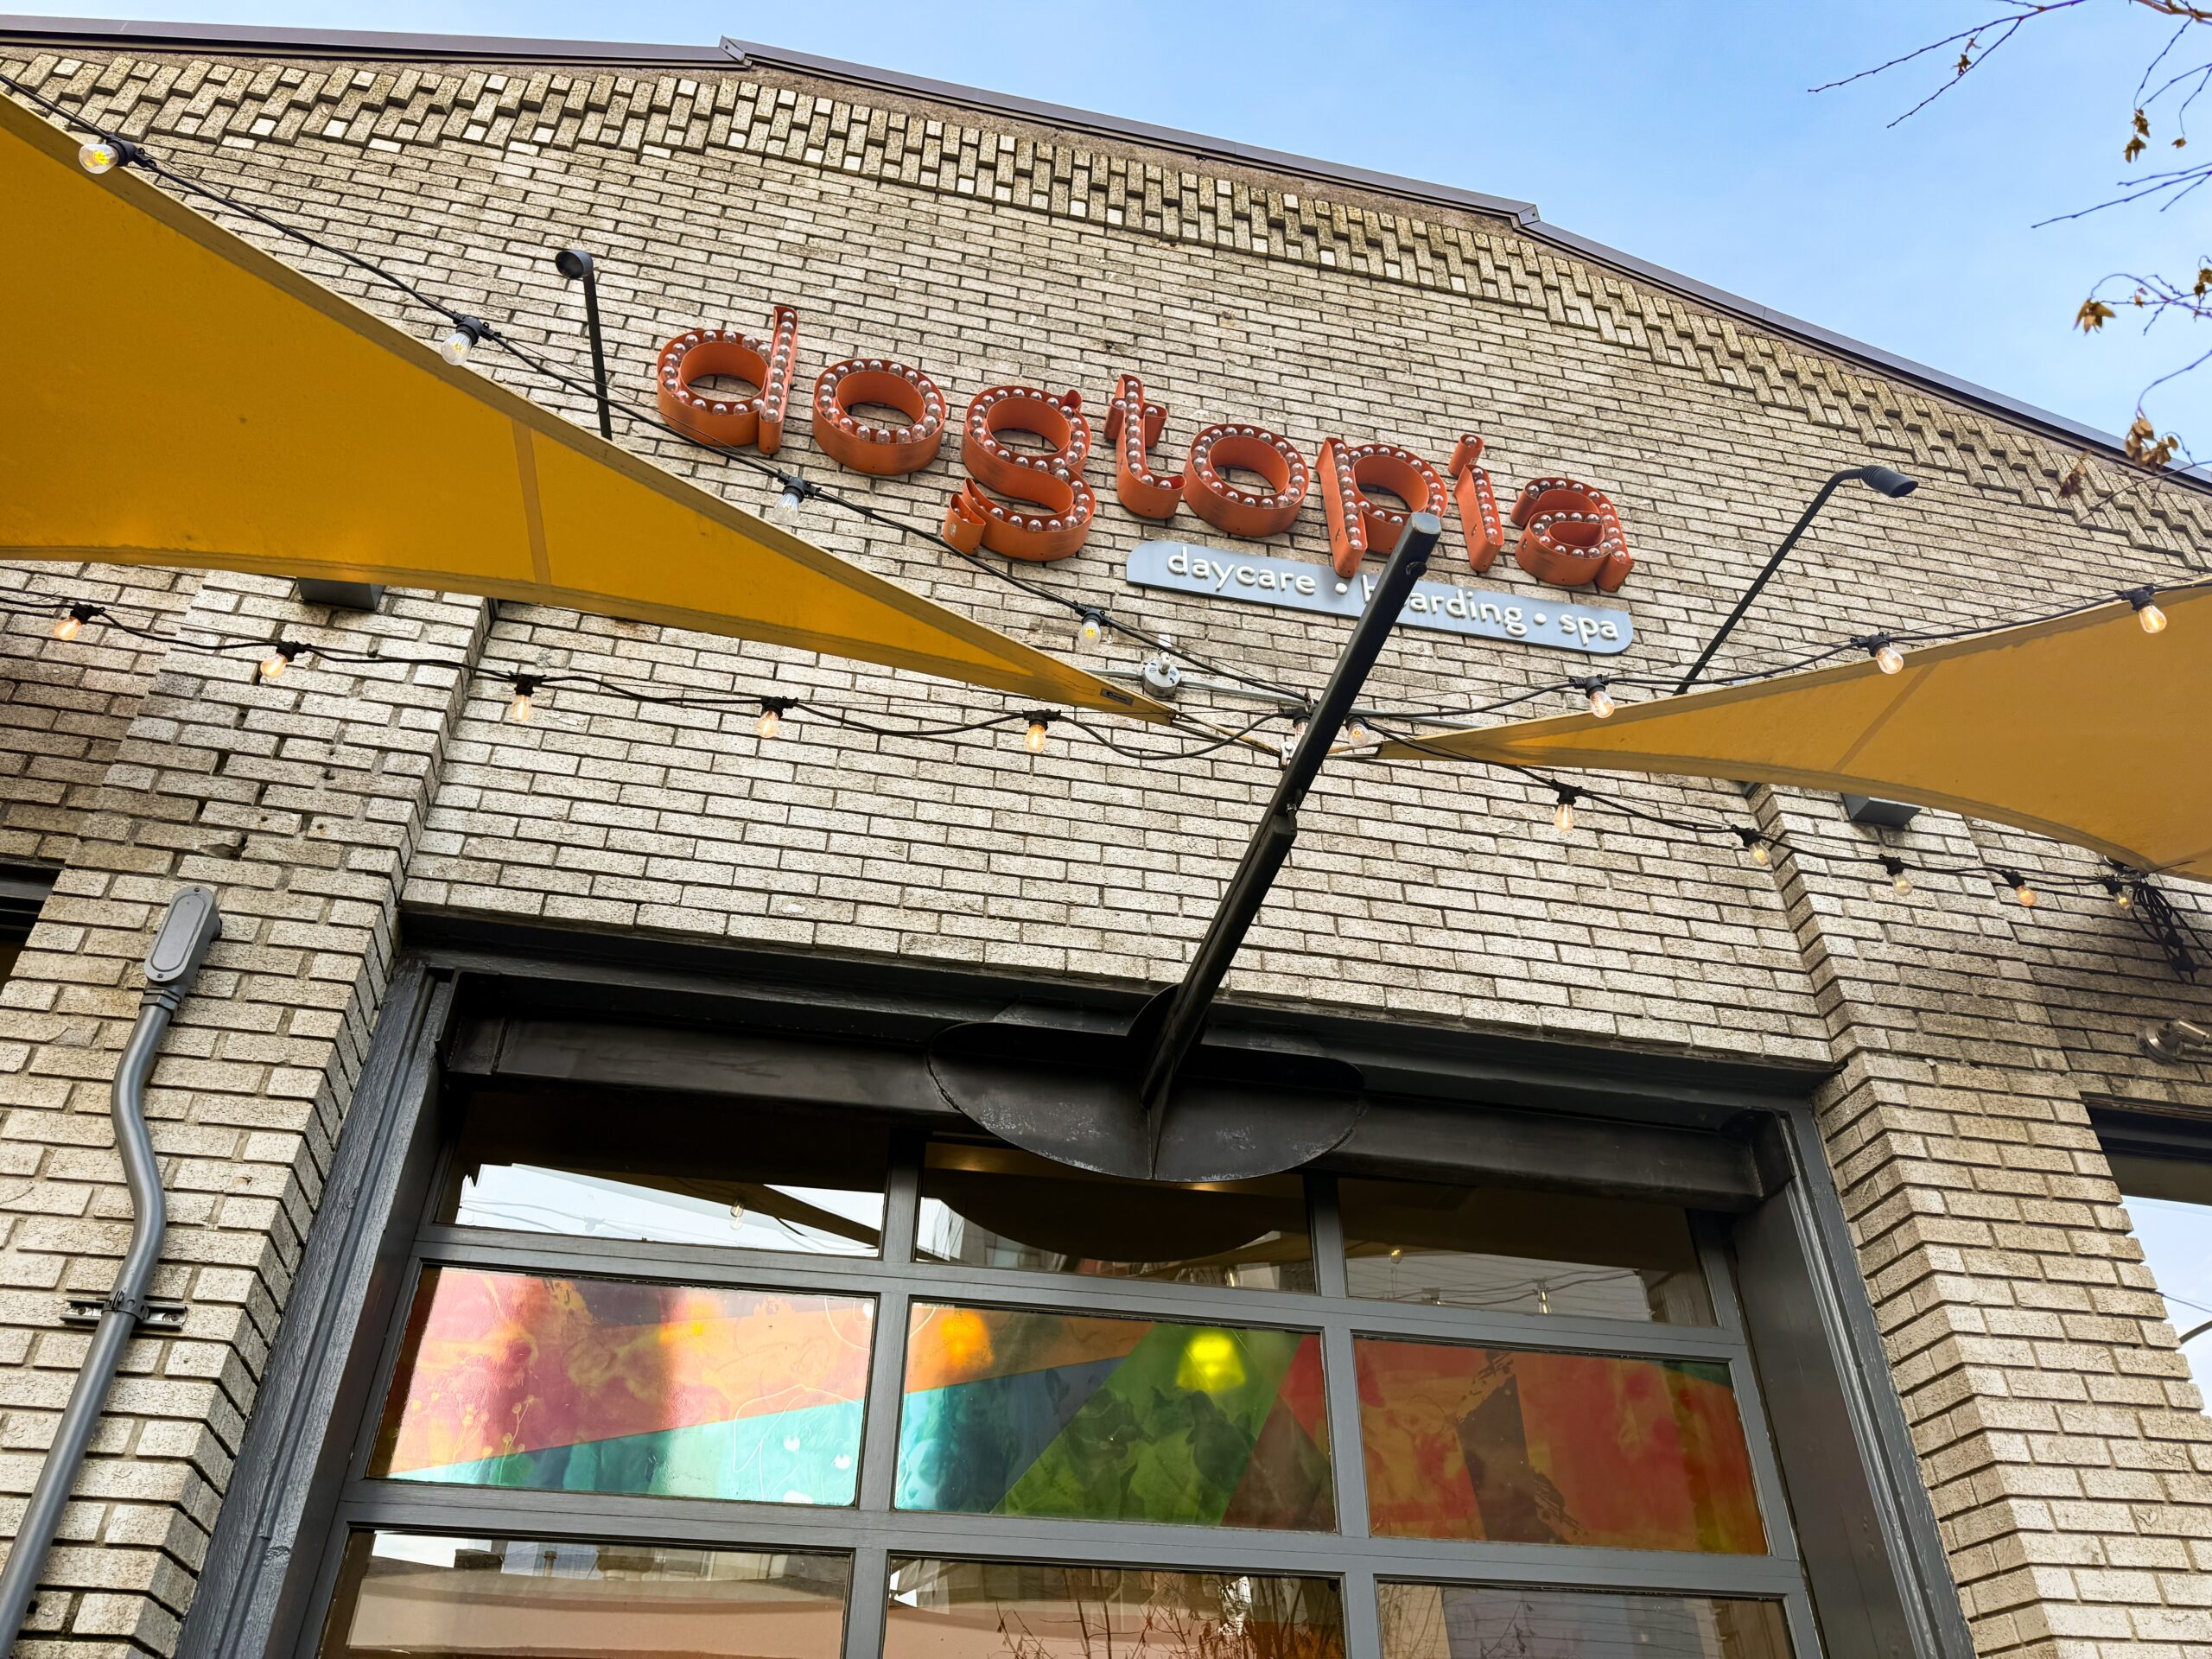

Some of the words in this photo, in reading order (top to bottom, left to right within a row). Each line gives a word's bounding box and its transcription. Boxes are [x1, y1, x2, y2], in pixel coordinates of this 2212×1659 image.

[657, 306, 1634, 592] dogtopia
[1167, 546, 1316, 594] daycare
[1362, 574, 1527, 637] barding
[1559, 613, 1619, 645] spa
